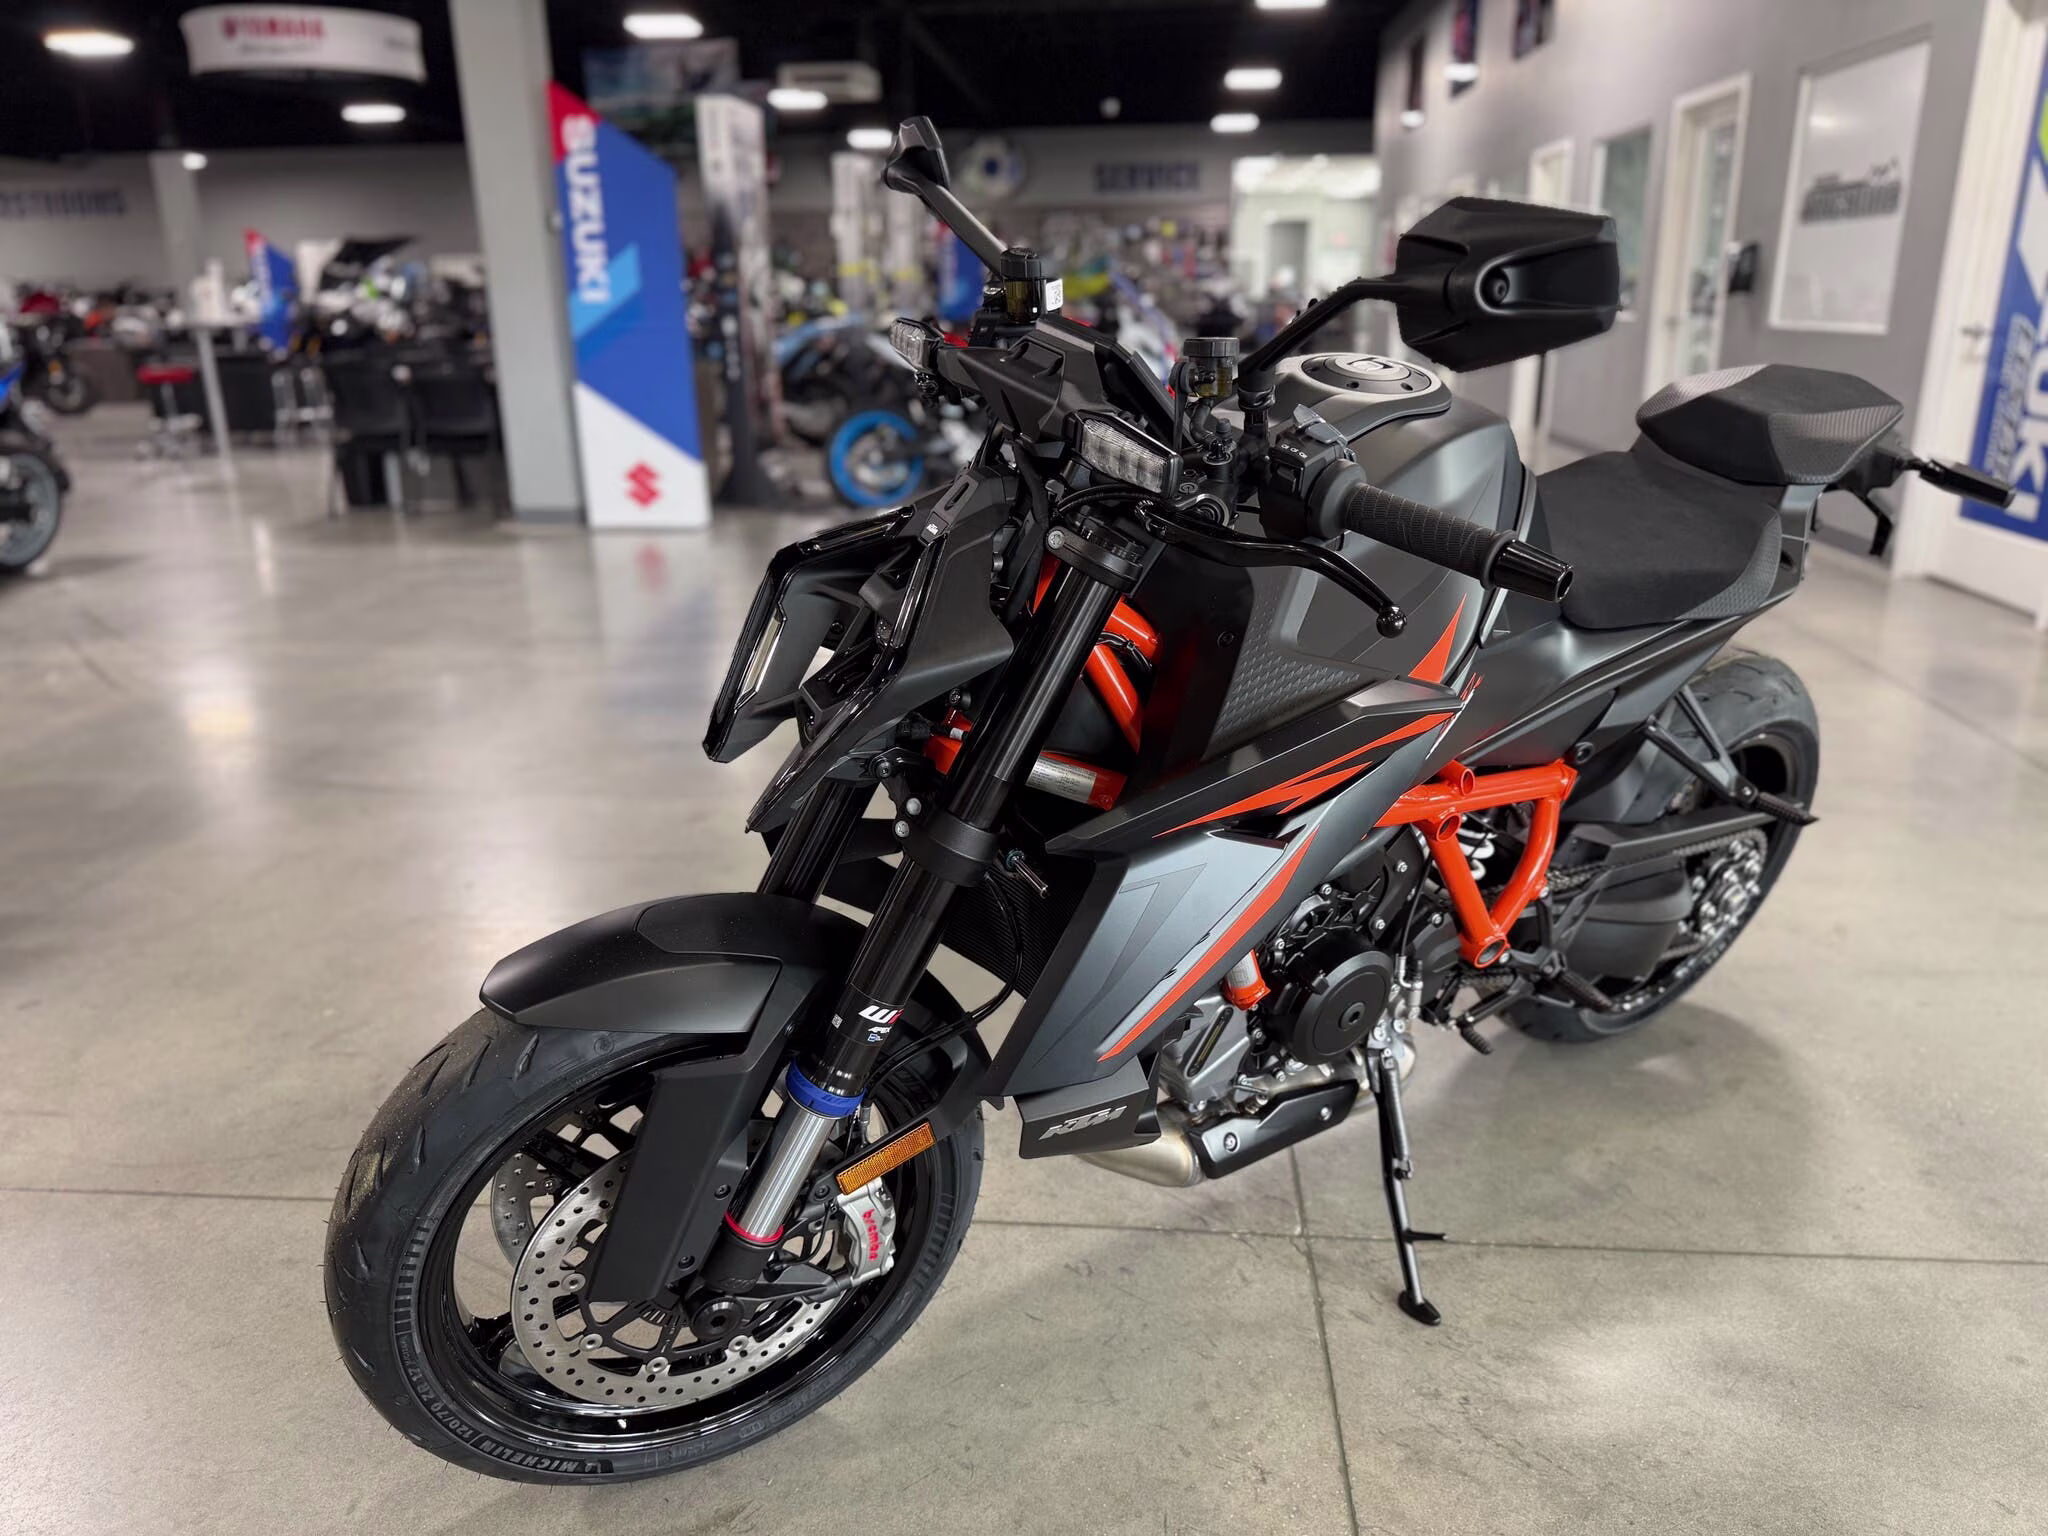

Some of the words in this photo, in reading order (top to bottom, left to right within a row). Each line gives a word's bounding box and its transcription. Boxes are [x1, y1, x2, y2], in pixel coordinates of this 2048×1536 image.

[561, 113, 611, 303] SUZUKI
[1038, 1105, 1128, 1141] KTM
[415, 1382, 436, 1401] ZR
[430, 1401, 475, 1441] 120/70
[478, 1438, 580, 1474] MICHELIN
